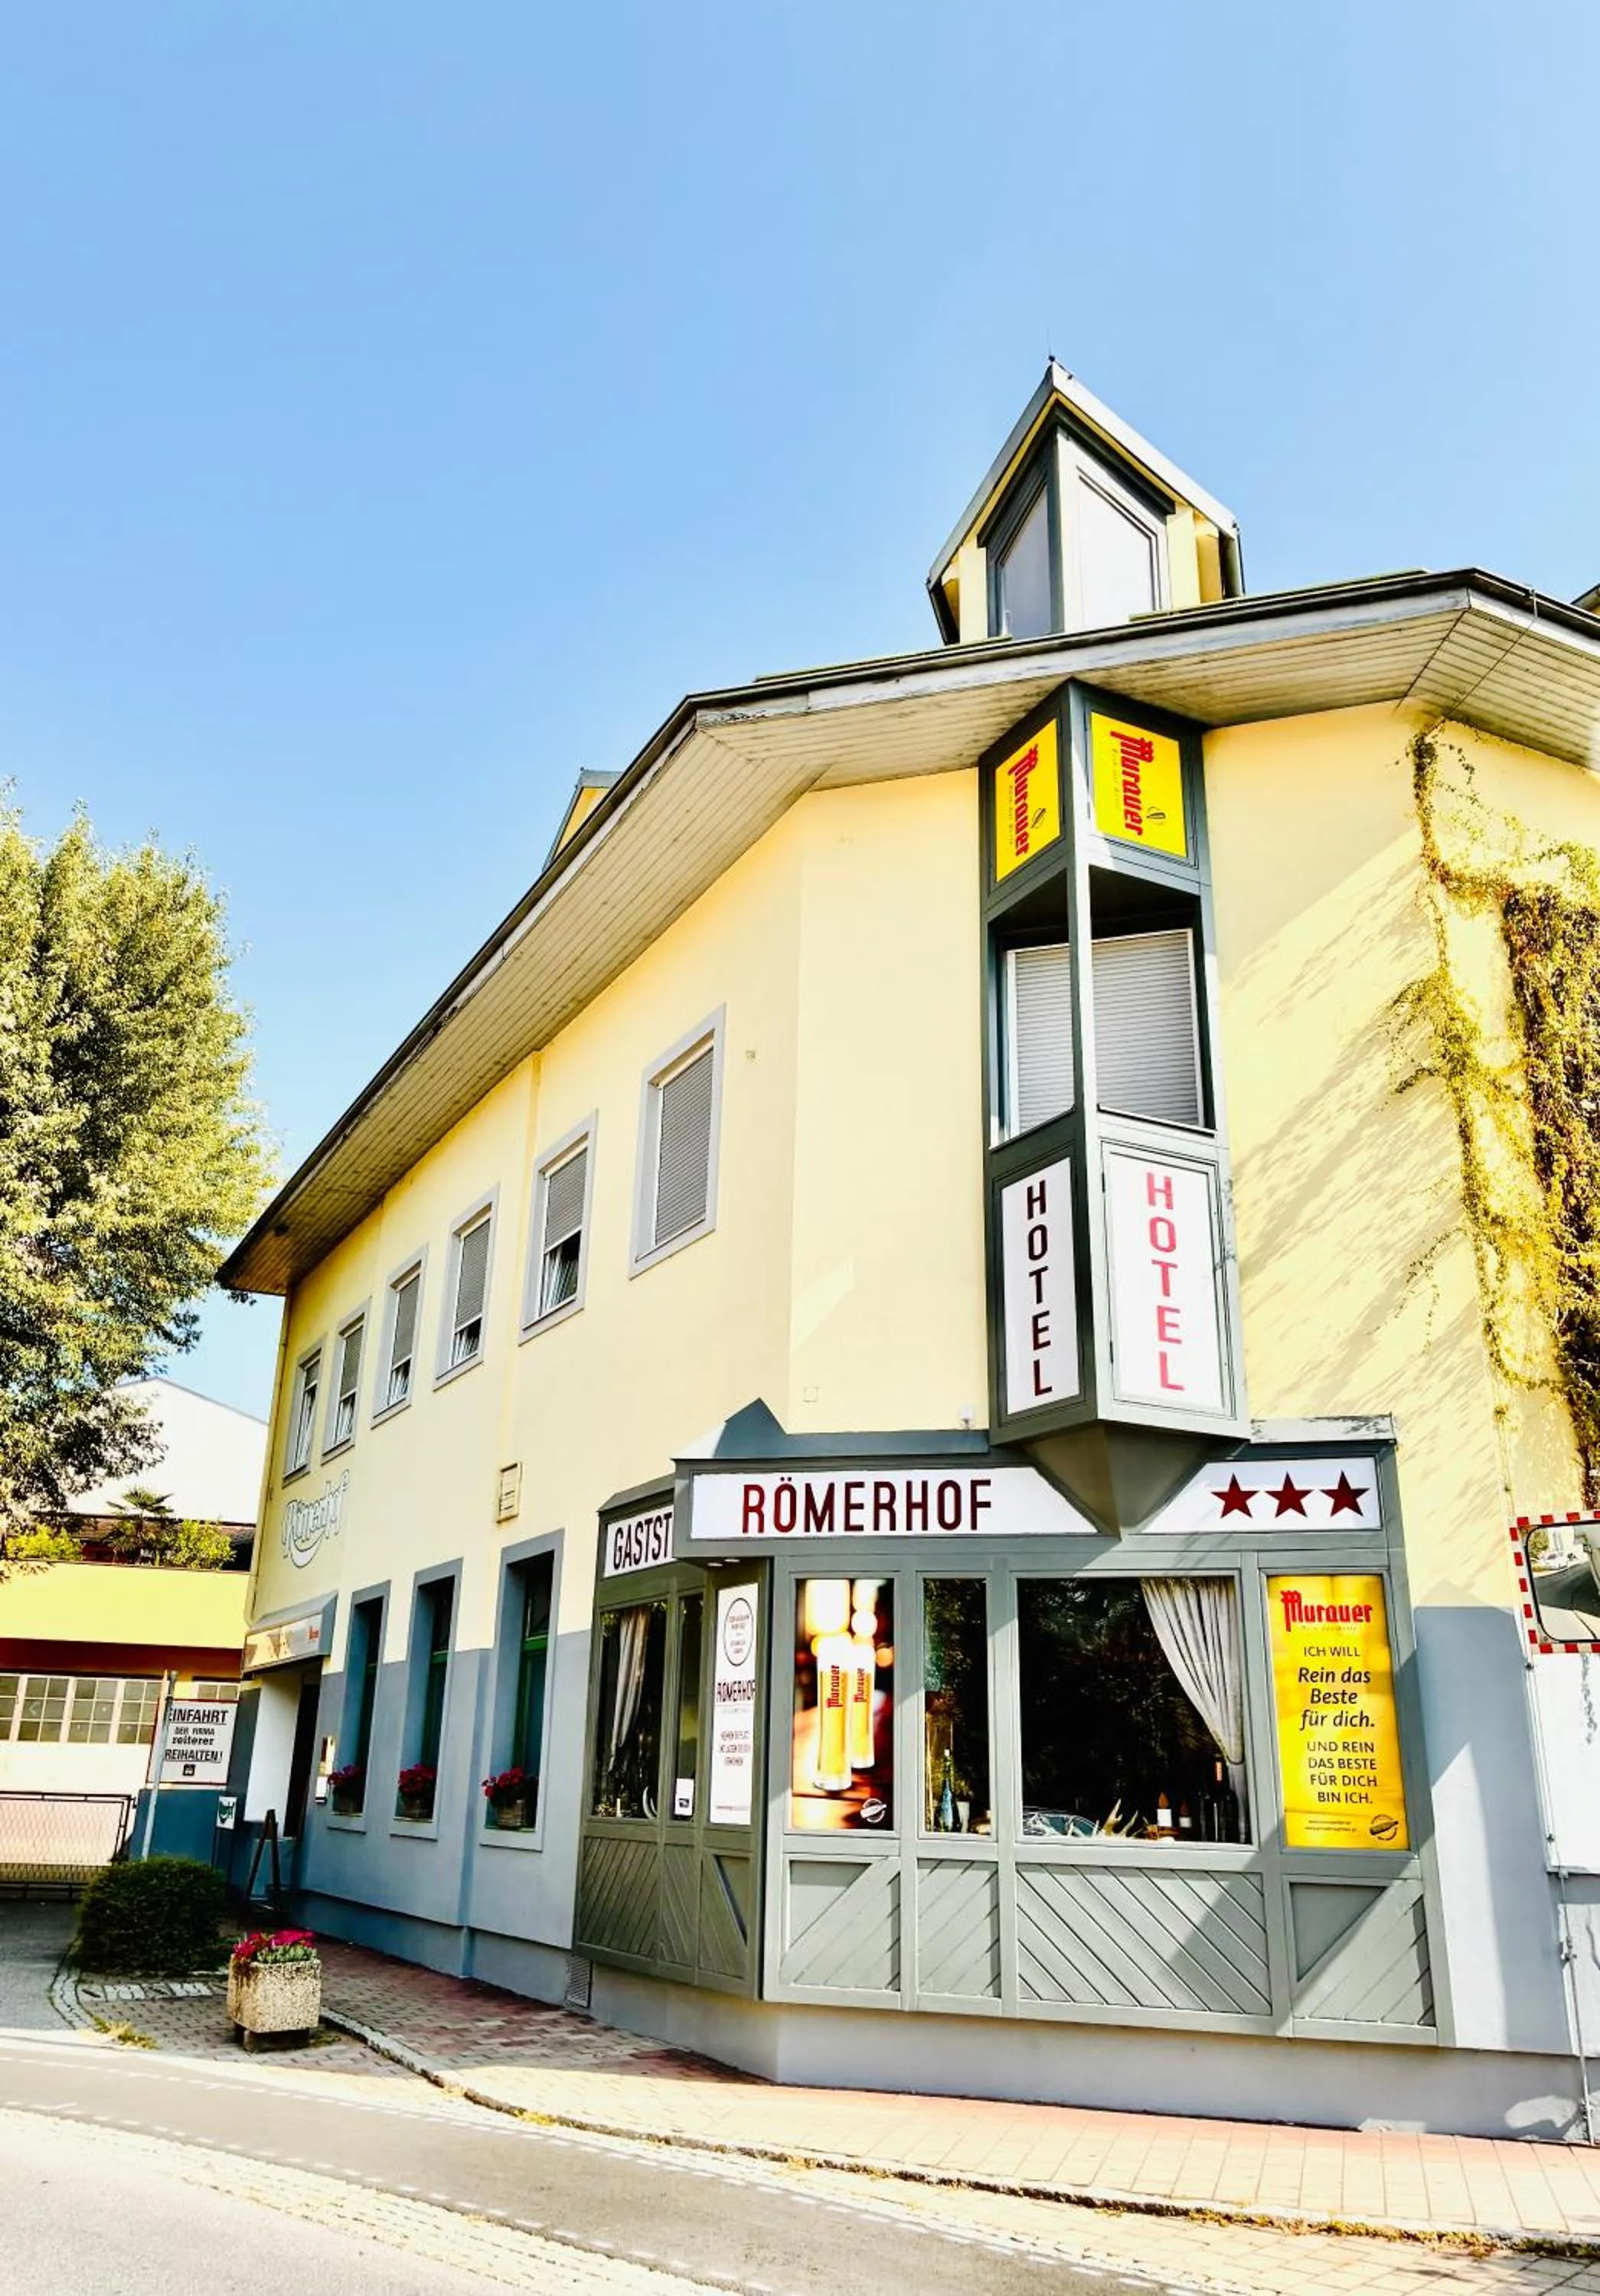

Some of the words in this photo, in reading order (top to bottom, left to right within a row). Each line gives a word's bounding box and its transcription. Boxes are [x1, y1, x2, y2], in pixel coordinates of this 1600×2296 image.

[1110, 731, 1154, 835] Murauer
[1007, 744, 1038, 856] Murauer
[1027, 1179, 1053, 1396] HOTEL
[1147, 1172, 1184, 1391] HOTEL
[742, 1477, 991, 1533] RÖMERHOF
[613, 1512, 672, 1570] GASTST
[1281, 1590, 1372, 1632] Murauer
[1304, 1647, 1326, 1656] ICH
[1331, 1647, 1360, 1656] WILL
[1298, 1667, 1335, 1683] Rein
[1341, 1667, 1370, 1683] das
[1311, 1688, 1357, 1704] Beste
[1300, 1709, 1327, 1731] für
[1333, 1710, 1375, 1727] dich.
[165, 1749, 223, 1761] REIHALTEN!
[1307, 1741, 1338, 1752] UND
[1343, 1742, 1374, 1753] REIN
[1308, 1758, 1334, 1769] DAS
[1338, 1758, 1377, 1769] BESTE
[1310, 1772, 1337, 1786] FÜR
[1342, 1775, 1377, 1786] DICH
[1318, 1792, 1340, 1803] BIN
[1345, 1792, 1373, 1804] ICH.
